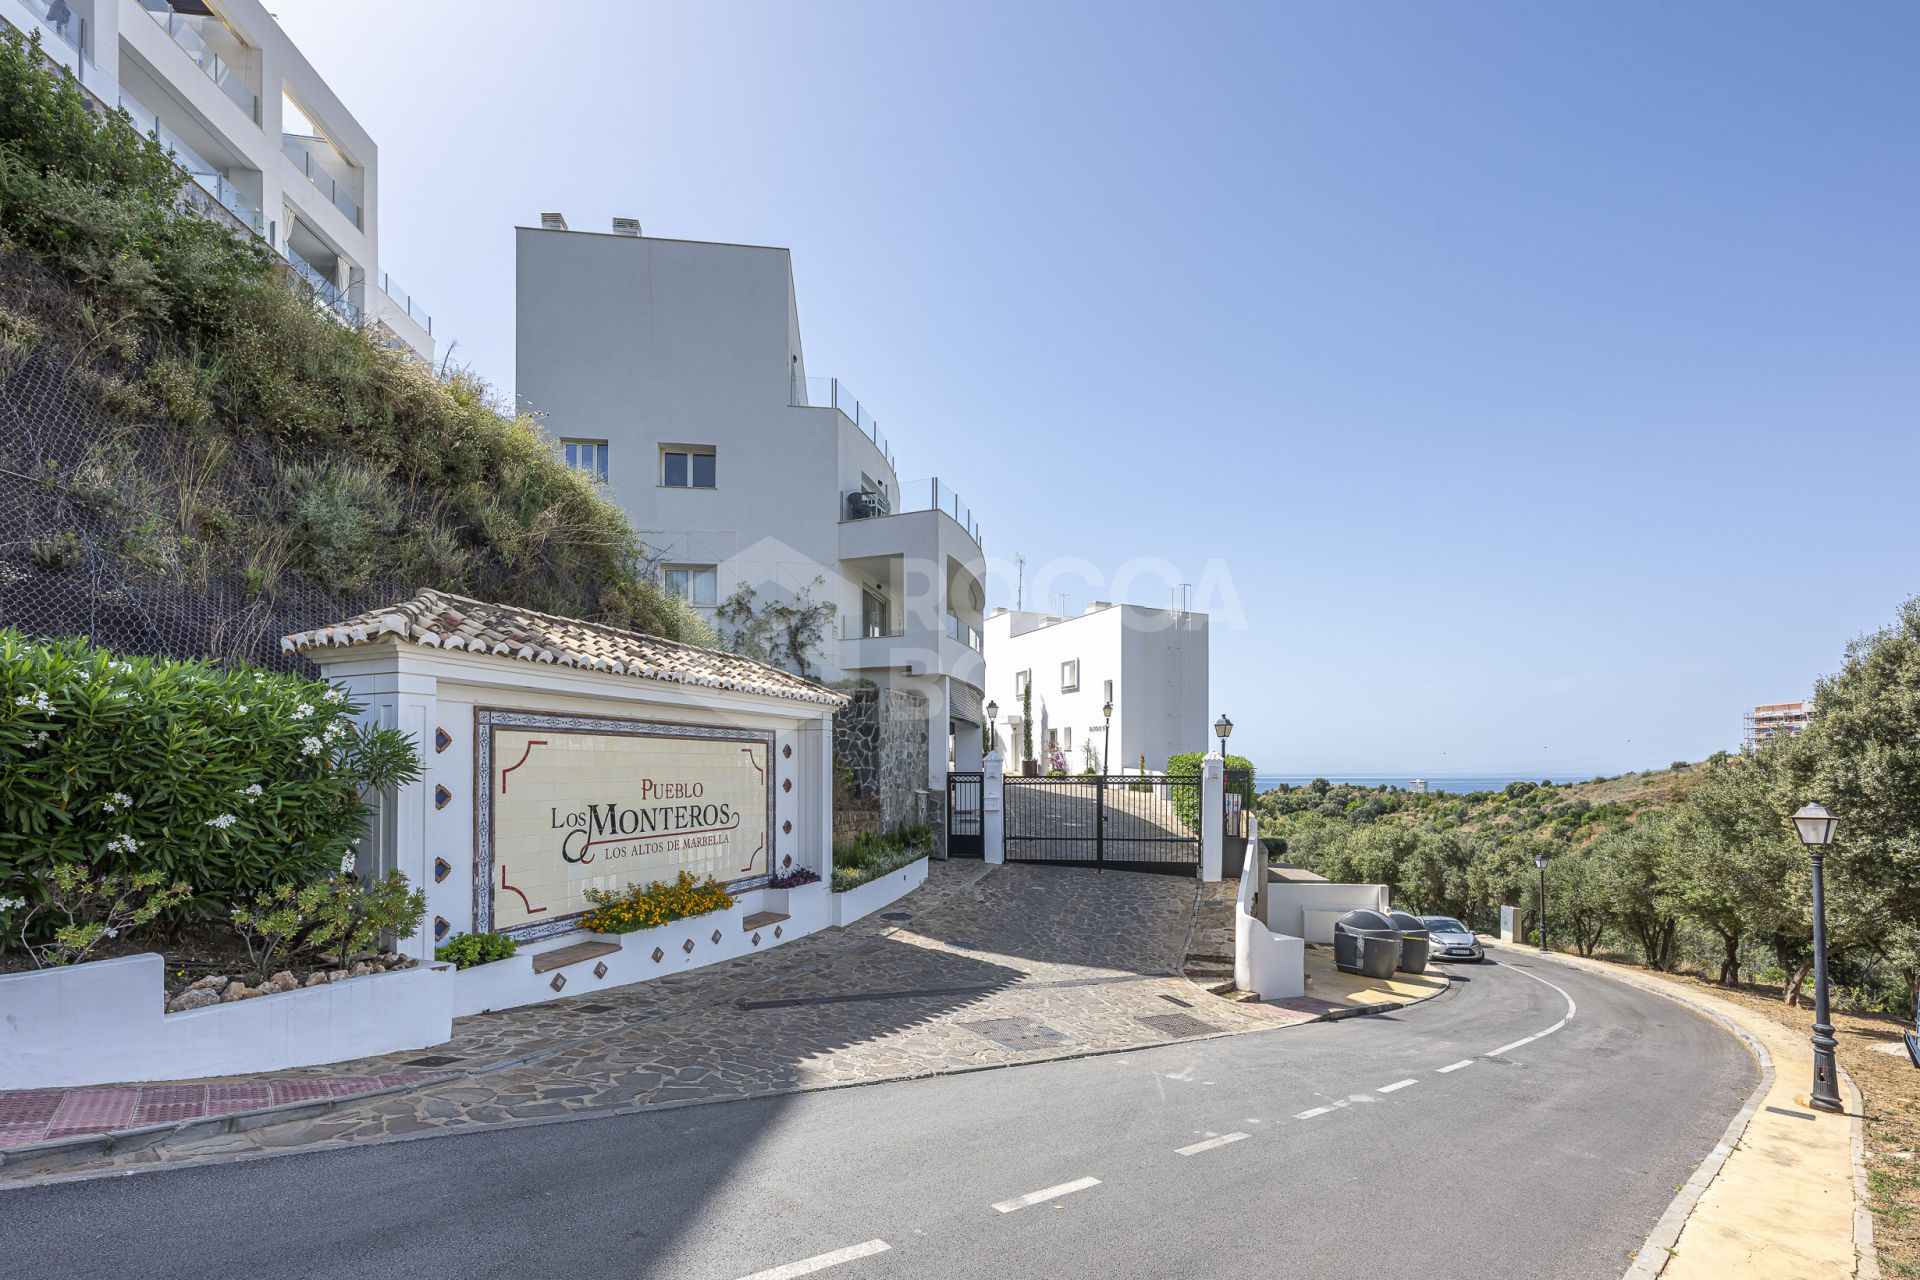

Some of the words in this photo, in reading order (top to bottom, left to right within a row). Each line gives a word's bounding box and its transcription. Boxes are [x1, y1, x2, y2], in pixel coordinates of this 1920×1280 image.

[641, 778, 704, 800] PUEBLO
[551, 807, 587, 829] LOS
[584, 803, 731, 845] MONTEROS
[605, 848, 627, 860] LOS
[631, 842, 664, 857] ALTOS
[667, 838, 680, 852] DE
[682, 833, 730, 850] MARBELLA
